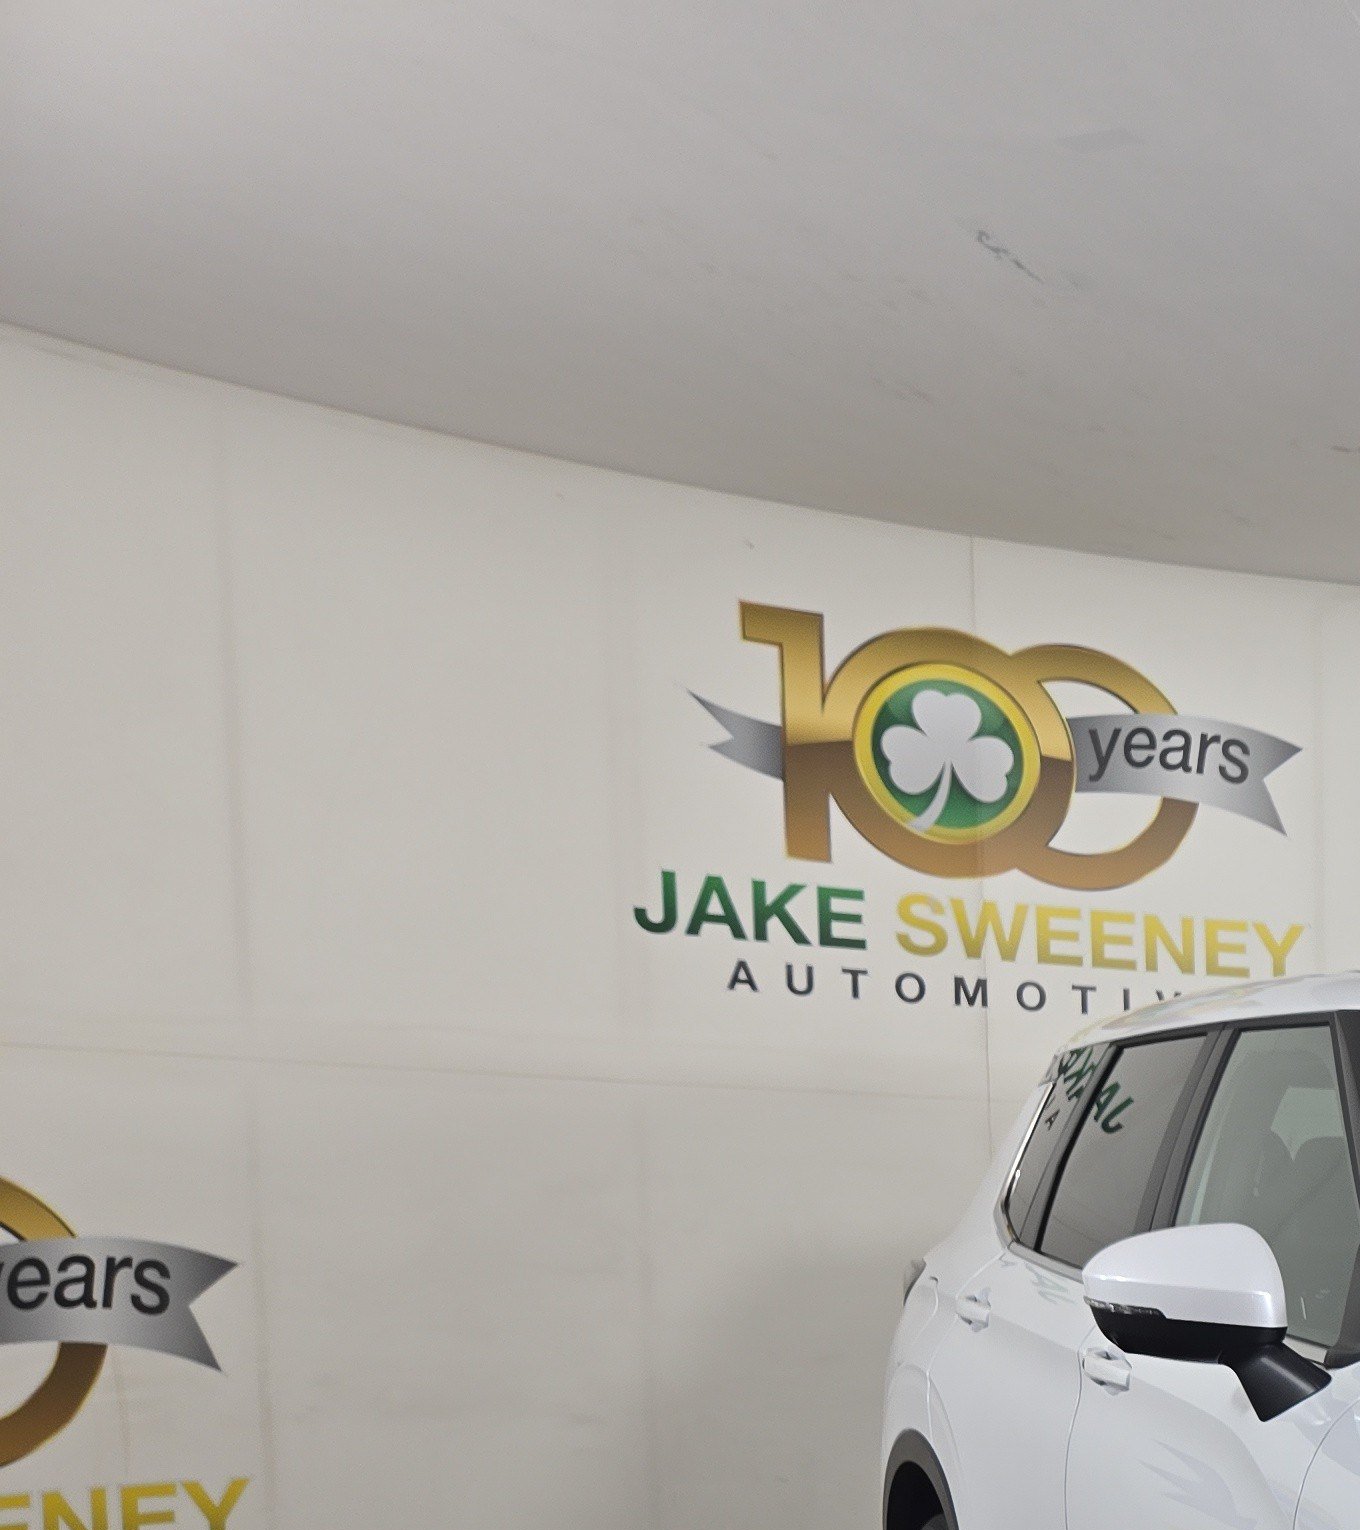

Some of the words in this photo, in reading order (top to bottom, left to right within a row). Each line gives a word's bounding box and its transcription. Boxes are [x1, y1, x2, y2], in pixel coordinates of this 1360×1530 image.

[739, 600, 1199, 891] 100
[1088, 720, 1252, 784] years
[633, 870, 868, 951] JAKE
[895, 892, 1306, 979] SWEENEY
[727, 959, 1181, 1015] AUTOMOTI
[0, 1253, 171, 1316] ears
